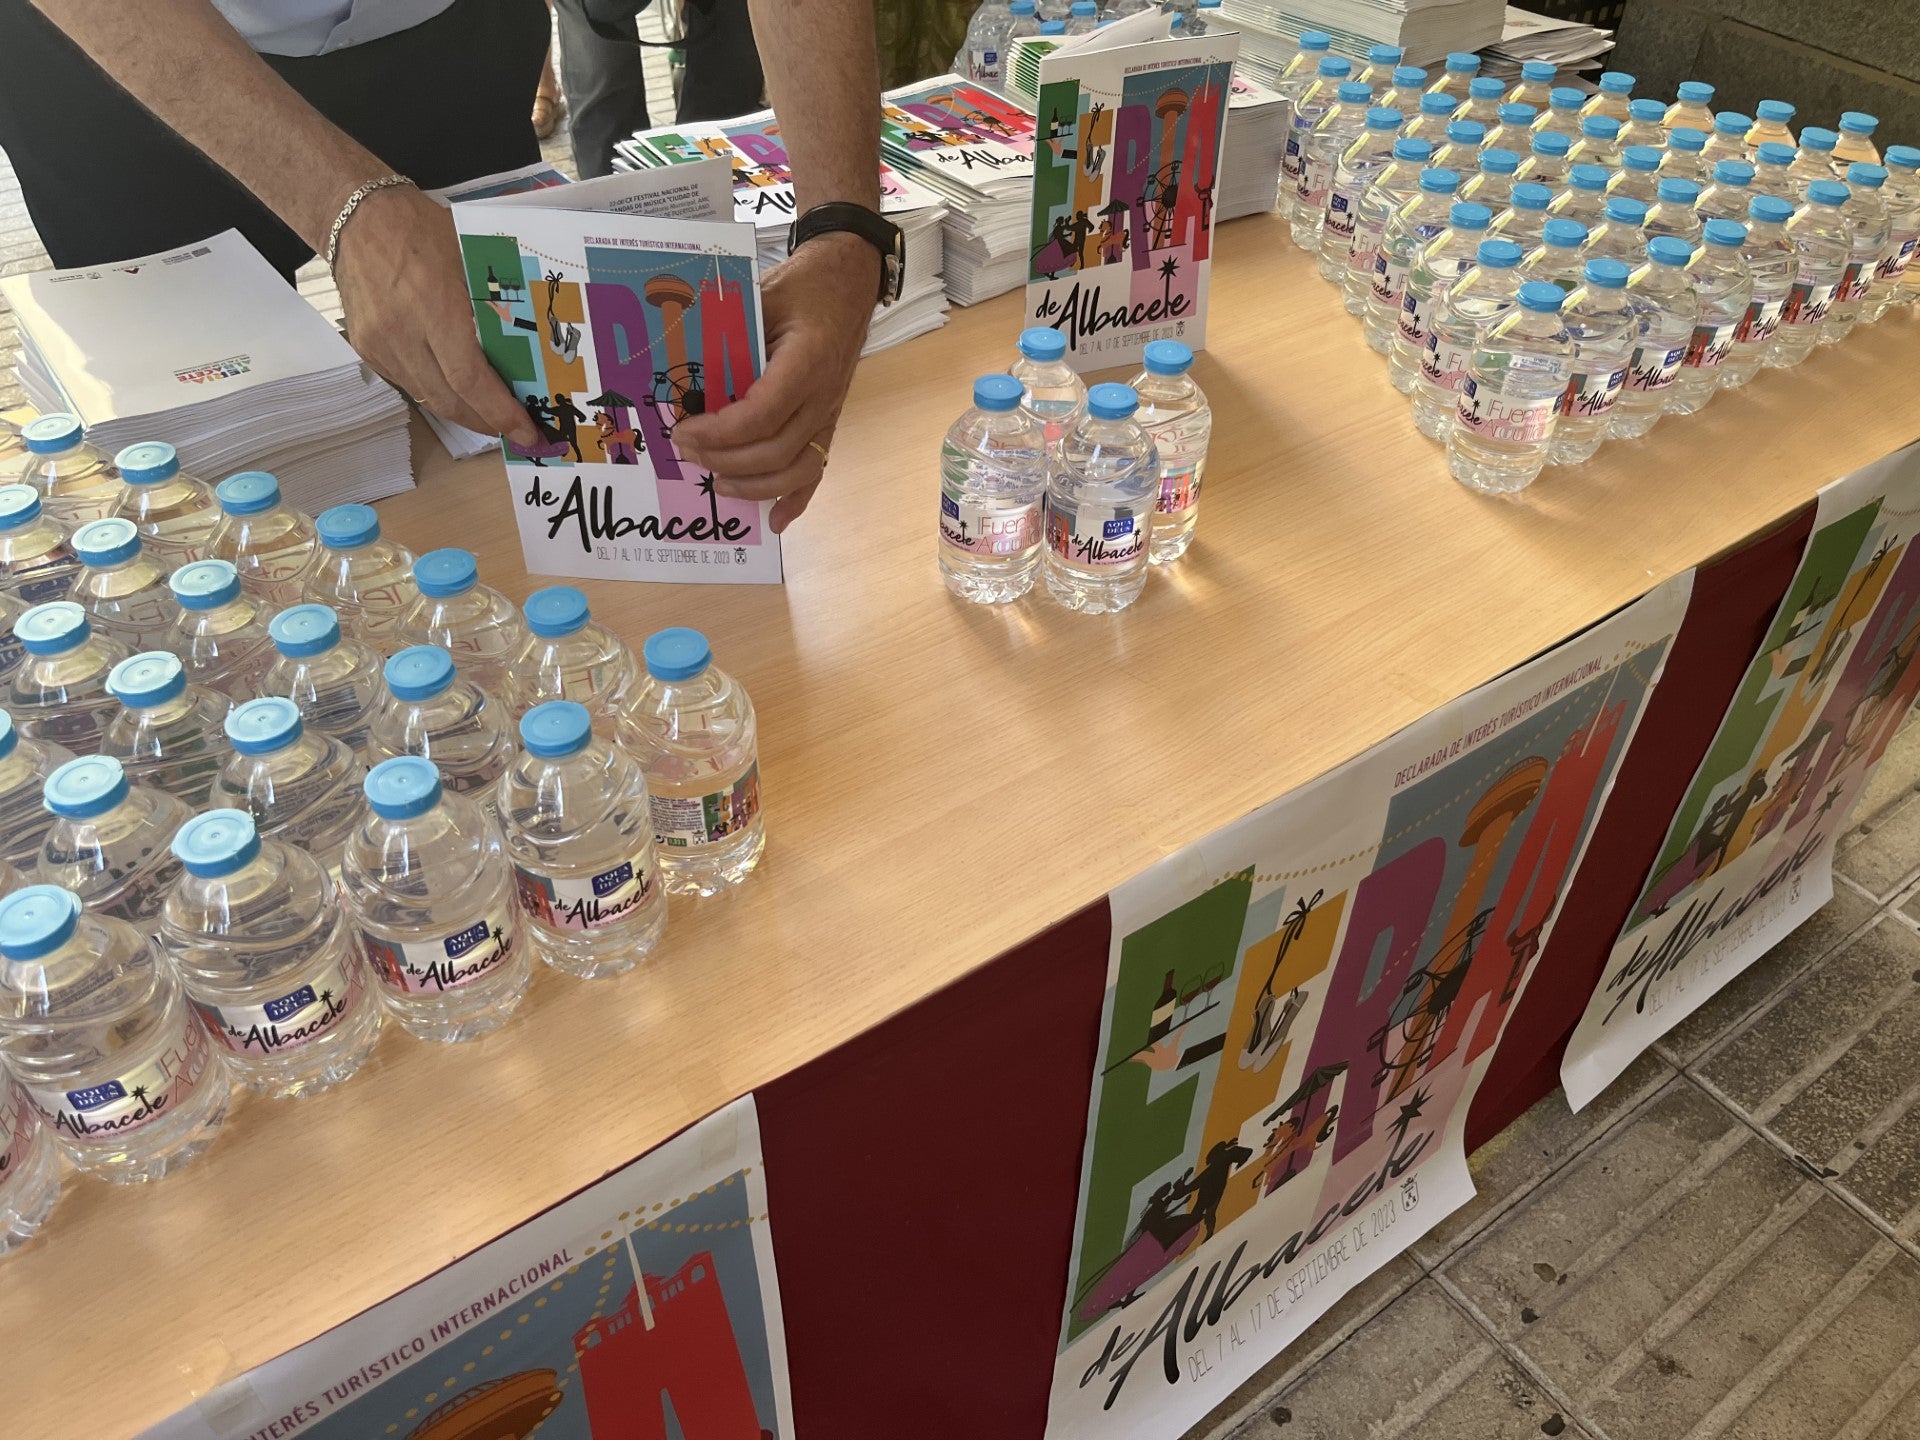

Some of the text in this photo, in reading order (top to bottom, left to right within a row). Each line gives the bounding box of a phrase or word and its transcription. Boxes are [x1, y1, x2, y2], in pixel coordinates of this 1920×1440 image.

[633, 192, 660, 202] FESTIVAL
[661, 187, 690, 196] NACIONAL
[584, 236, 612, 246] DECLARADA
[612, 238, 618, 246] DE
[619, 238, 639, 248] INTERÉS
[664, 242, 702, 252] INTERNACIONAL
[1036, 281, 1191, 351] de Albacete
[525, 471, 751, 553] de Albacete
[1106, 525, 1132, 535] DEUS
[1107, 519, 1133, 529] AQUA
[1072, 534, 1084, 546] de
[1076, 533, 1144, 565] Albacete
[597, 547, 730, 564] DEL 7 AL 17 DE SEPTIEMBRE DE 2023
[1394, 656, 1603, 788] DECLARADA DE INTERÉS TURÍSTICO INTERNACIONAL
[597, 865, 630, 884] AQUA
[599, 872, 630, 890] DEUS
[555, 878, 651, 929] de Albacete
[450, 924, 484, 944] AQUA
[452, 931, 486, 951] DEUS
[406, 935, 514, 991] de Albacete
[1605, 935, 1654, 993] de
[270, 988, 309, 1009] AQUA
[273, 995, 311, 1016] DEUS
[228, 996, 348, 1054] de Albacete
[1064, 700, 1628, 1346] FERIA
[73, 1082, 117, 1100] AQUA
[77, 1090, 119, 1106] DEUS
[53, 1092, 168, 1139] Albacete
[1079, 1130, 1435, 1412] de Albacete
[1187, 1203, 1396, 1383] DEL 7 AL 17 DE SEPTIEMBRE DE 2023
[321, 1336, 426, 1406] TURÍSTICO
[430, 1247, 574, 1344] INTERNACIONAL
